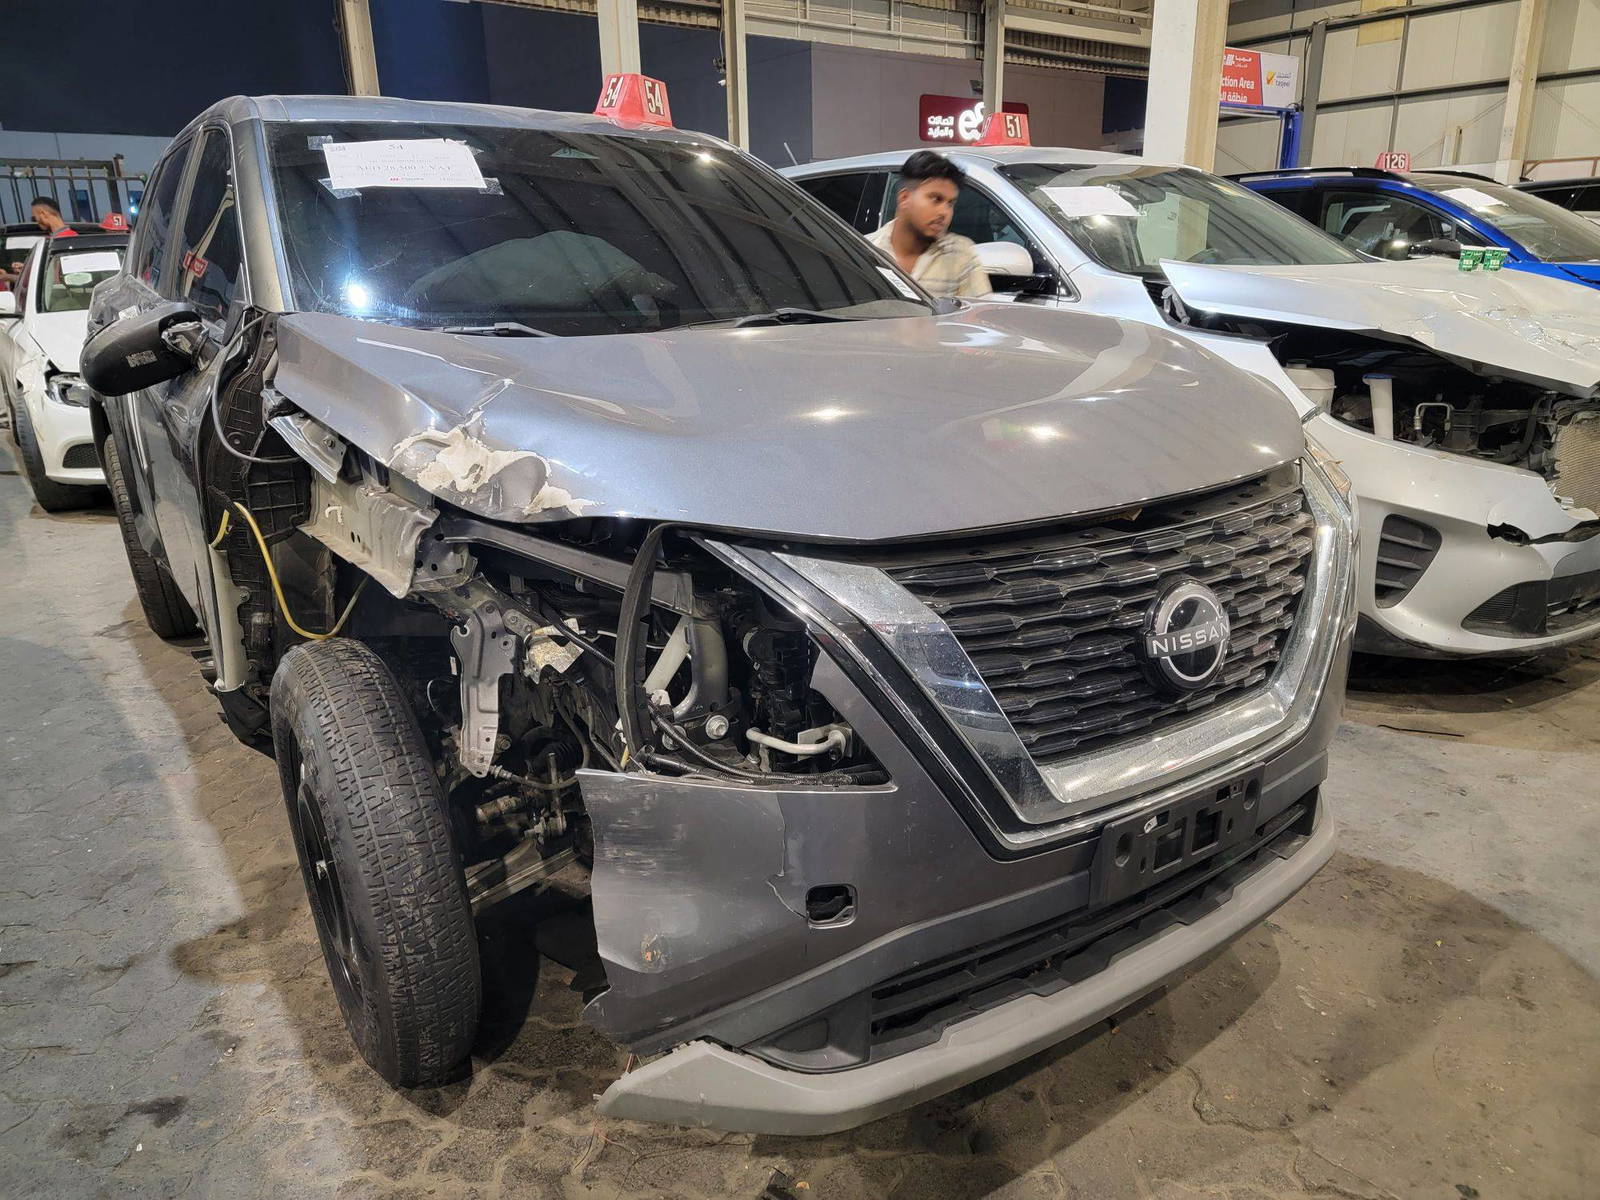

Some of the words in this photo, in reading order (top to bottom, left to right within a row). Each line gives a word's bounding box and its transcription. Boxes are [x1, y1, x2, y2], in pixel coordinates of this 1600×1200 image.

[602, 76, 624, 107] 54
[1238, 77, 1255, 89] Area
[644, 79, 664, 115] 54
[1006, 115, 1021, 138] 51
[1385, 154, 1405, 169] 126
[1152, 622, 1229, 655] NISSAN
